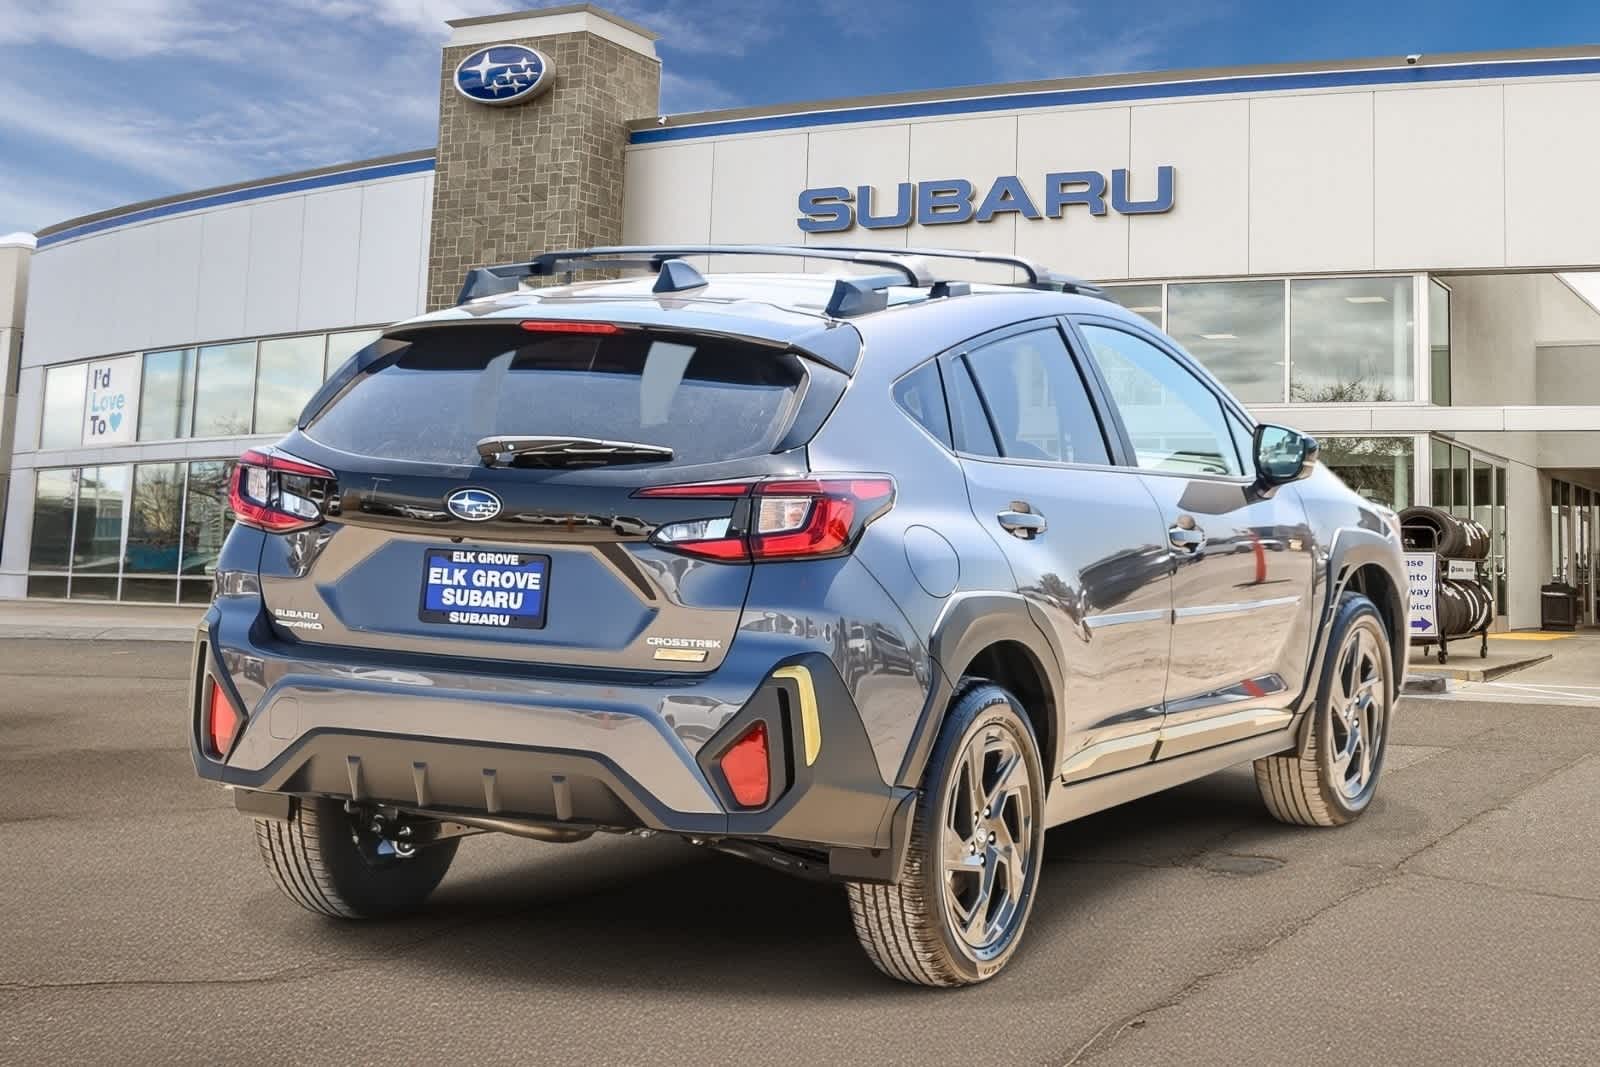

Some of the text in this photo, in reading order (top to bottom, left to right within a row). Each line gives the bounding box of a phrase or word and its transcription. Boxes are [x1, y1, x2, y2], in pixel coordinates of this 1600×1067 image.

[796, 165, 1175, 233] SUBARU
[93, 367, 111, 389] I'd
[91, 392, 125, 412] Love
[90, 415, 106, 435] To
[452, 551, 519, 566] ELK GROVE
[428, 567, 541, 590] ELK GROVE
[1409, 573, 1428, 581] nto
[441, 588, 523, 609] SUBARU
[1411, 602, 1432, 610] vice
[275, 608, 320, 620] SUBARU
[449, 611, 510, 626] SUBARU
[646, 637, 721, 649] CROSSTREK
